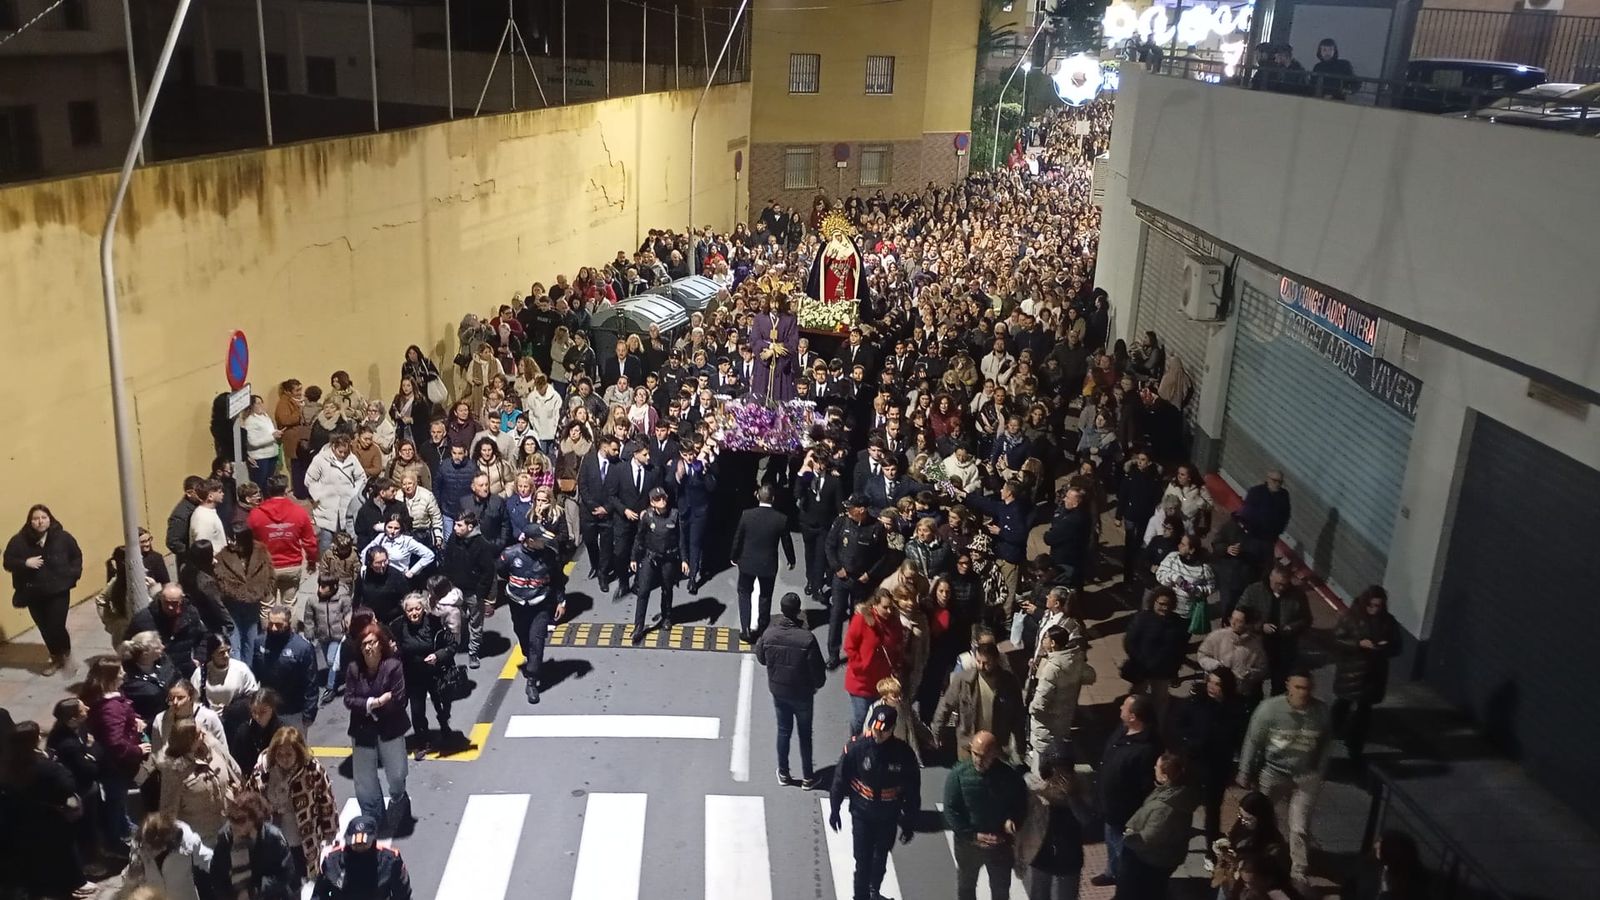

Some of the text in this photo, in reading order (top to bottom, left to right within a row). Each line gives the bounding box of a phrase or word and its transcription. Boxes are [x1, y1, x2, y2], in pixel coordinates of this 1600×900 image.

[1298, 284, 1347, 329] CONGELADOS
[1345, 307, 1376, 346] VIVERA
[1285, 312, 1418, 415] CONGELADOS VIVER
